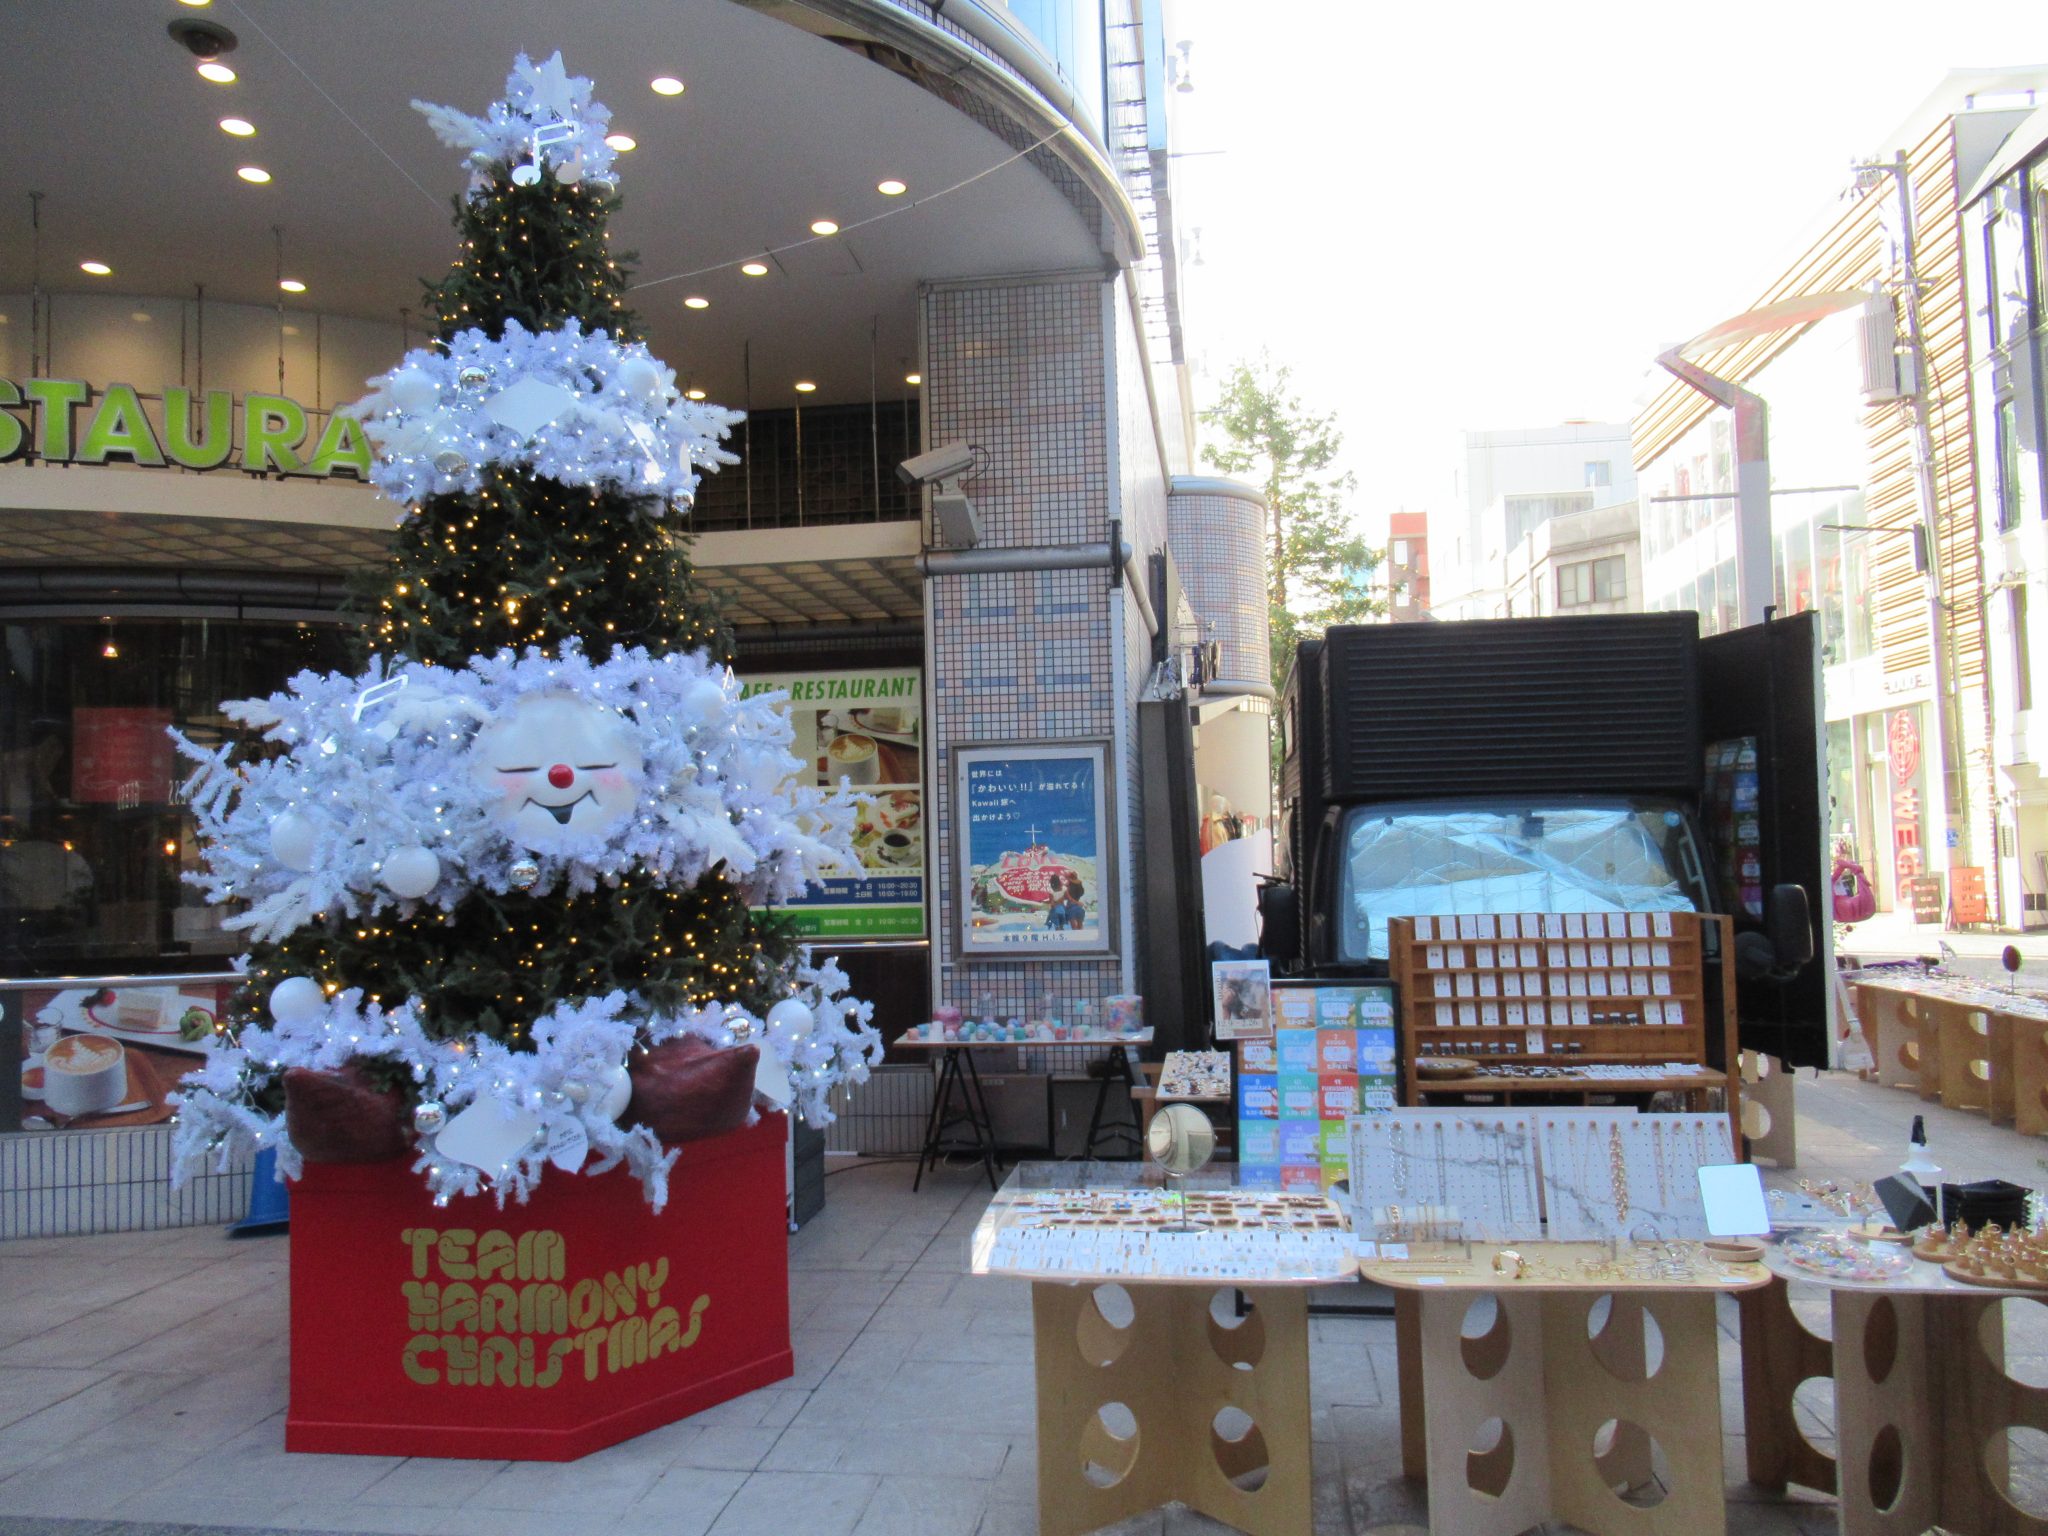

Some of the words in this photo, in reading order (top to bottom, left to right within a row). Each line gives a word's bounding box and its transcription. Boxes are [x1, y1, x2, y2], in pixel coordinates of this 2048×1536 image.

[740, 682, 773, 700] AFE
[791, 676, 917, 700] RESTAURANT
[971, 769, 1003, 778] 世界には
[401, 1228, 566, 1281] TEAM
[401, 1256, 669, 1335] HARMONY
